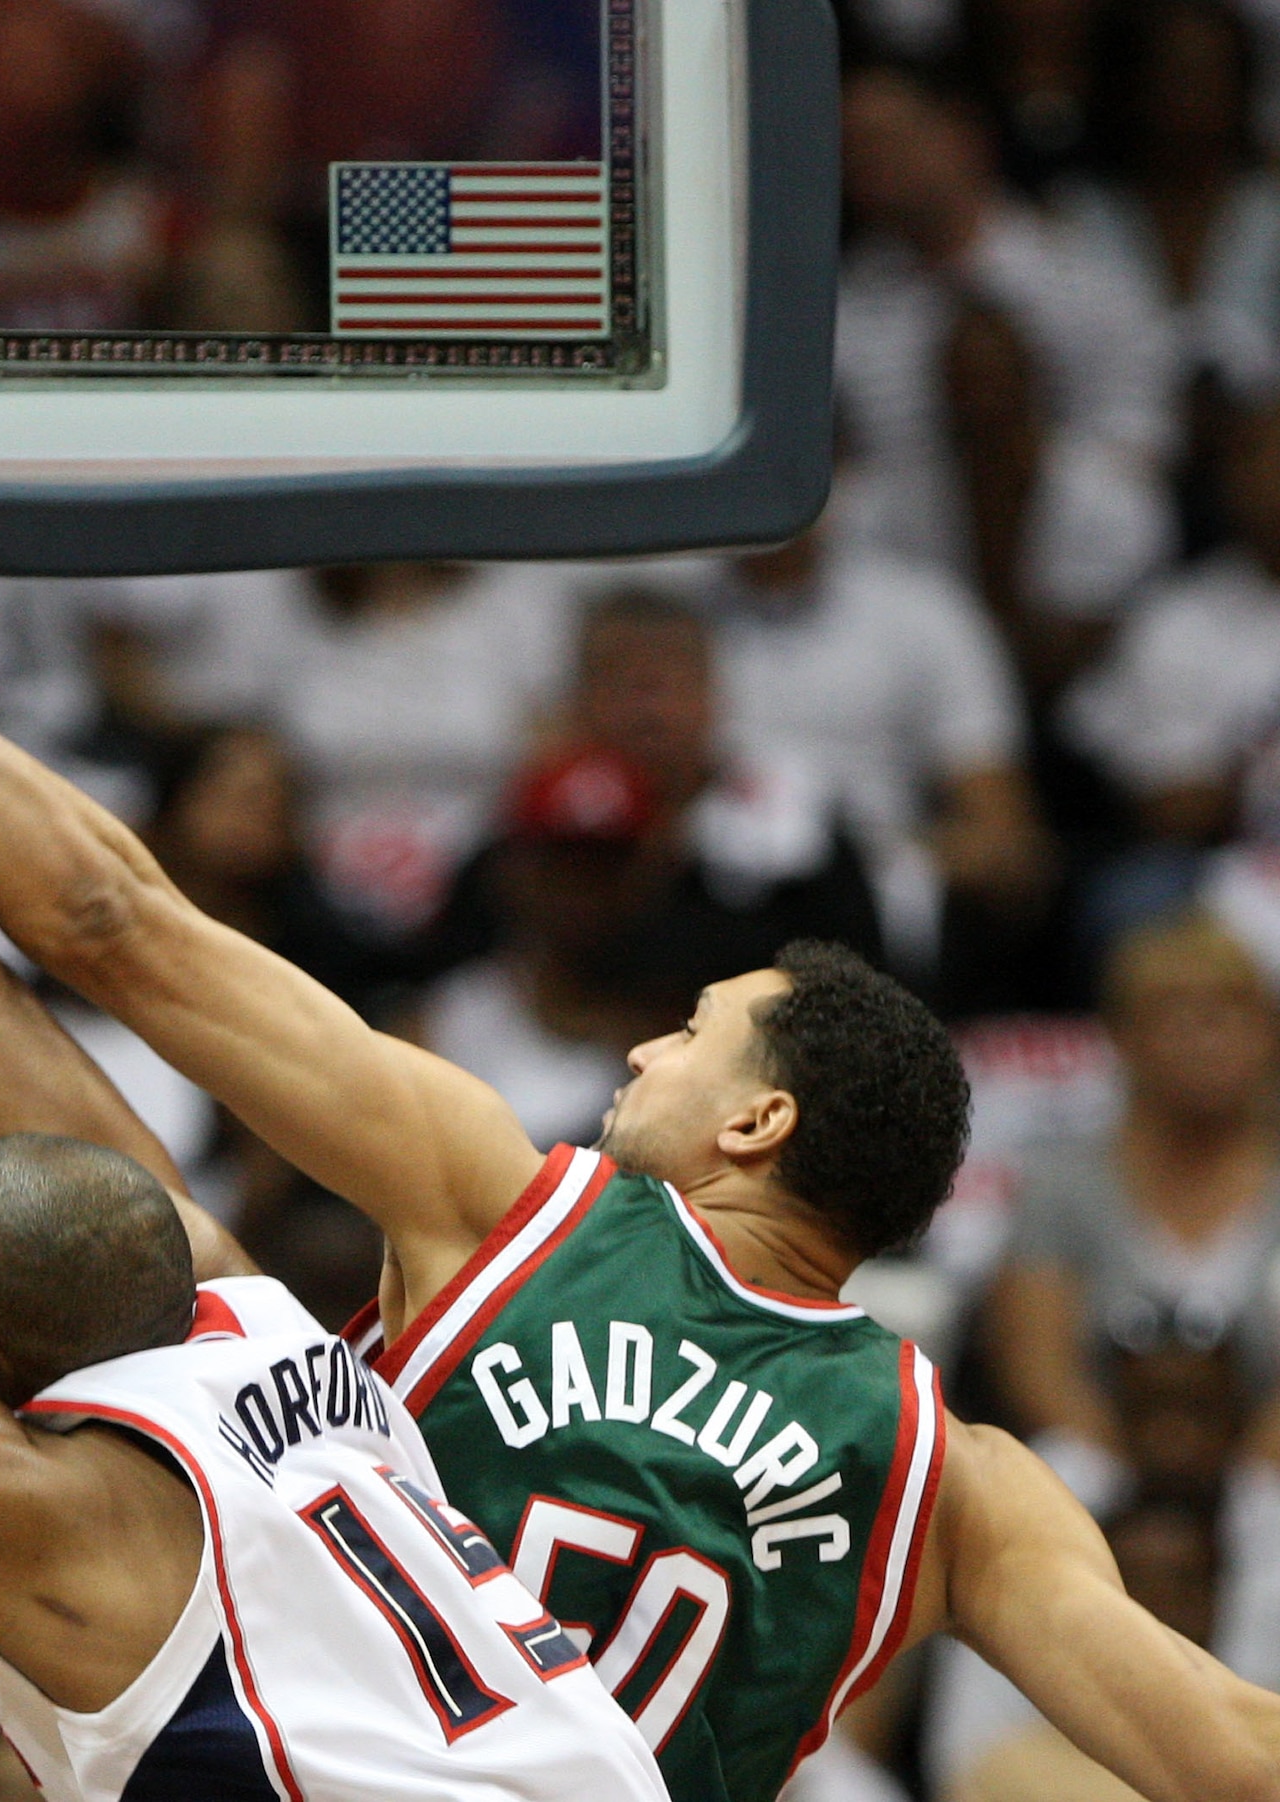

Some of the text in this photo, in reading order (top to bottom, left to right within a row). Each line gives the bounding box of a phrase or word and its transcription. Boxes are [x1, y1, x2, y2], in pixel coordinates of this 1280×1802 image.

[218, 1340, 391, 1490] HORFORD
[470, 1320, 851, 1572] GADZURIC
[297, 1465, 590, 1747] 15
